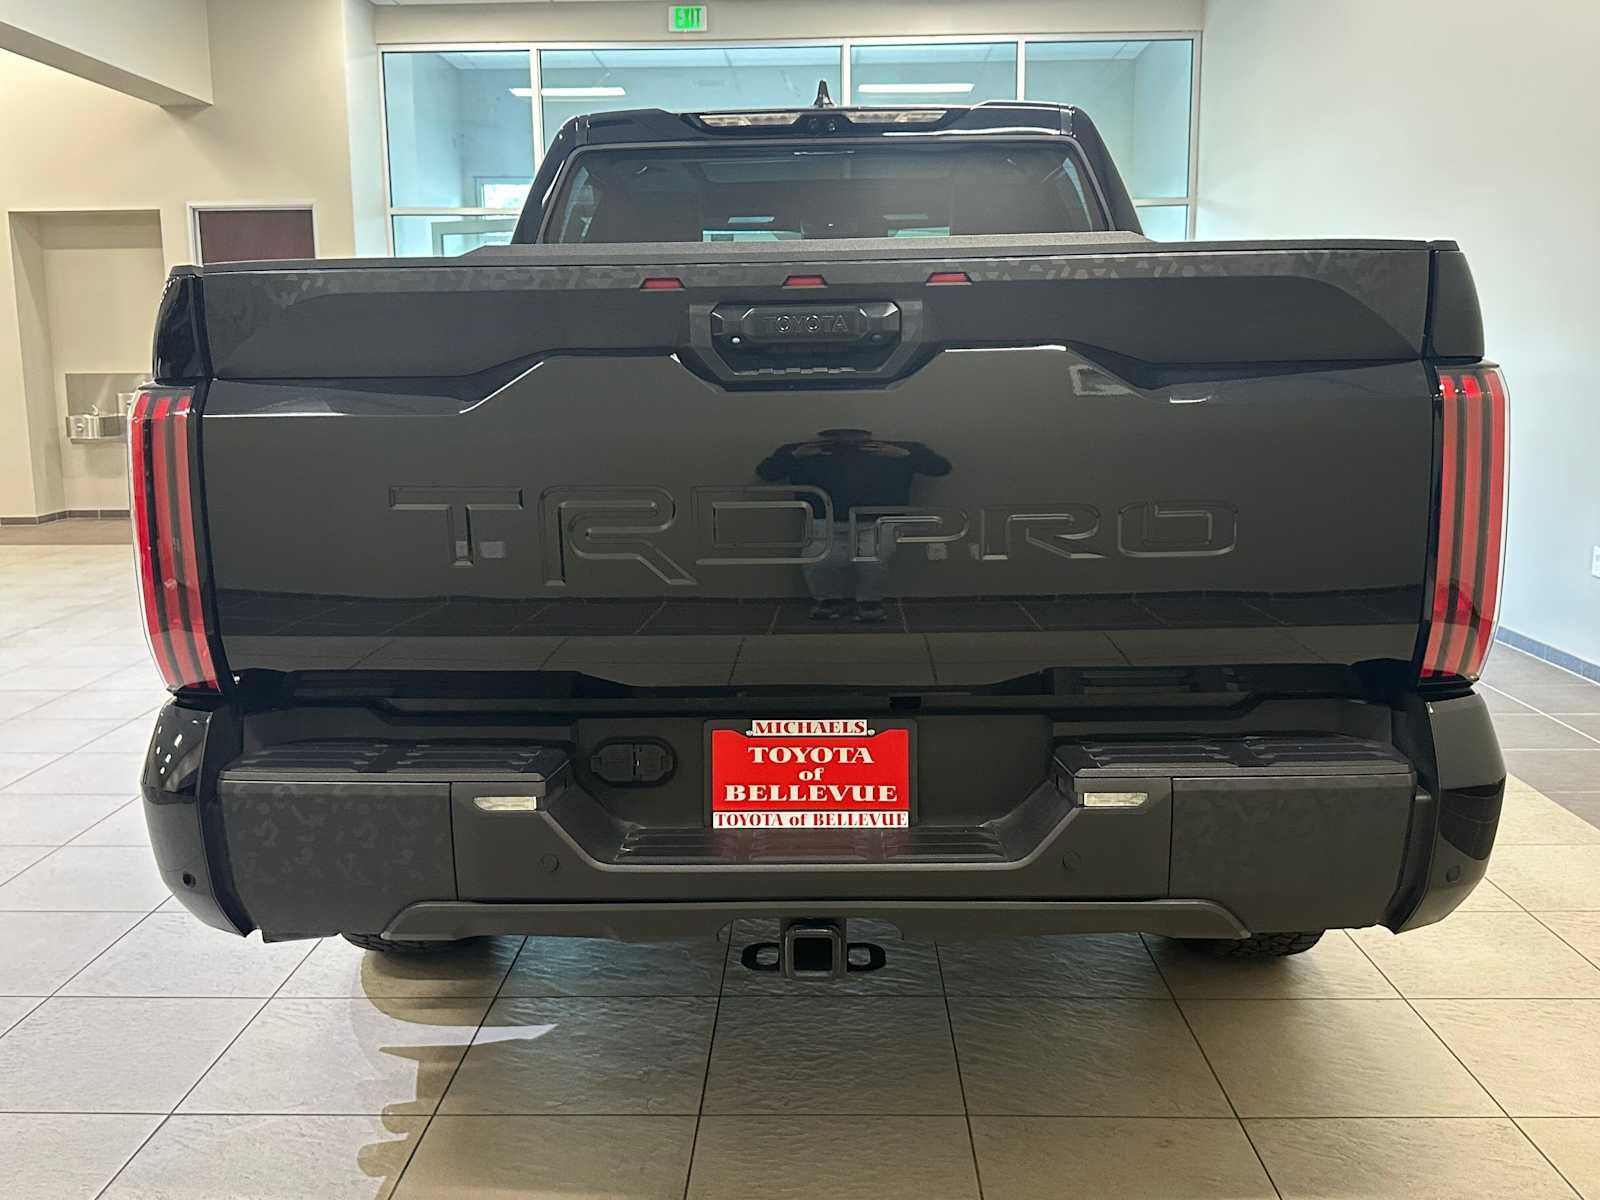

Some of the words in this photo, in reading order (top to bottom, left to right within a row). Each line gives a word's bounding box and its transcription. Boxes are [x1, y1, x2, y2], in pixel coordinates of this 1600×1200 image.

[675, 7, 702, 29] EXIT
[762, 315, 849, 333] TOYOTA
[388, 484, 833, 587] TRD
[848, 499, 1239, 563] PRO
[754, 721, 865, 734] MICHAELS
[748, 747, 875, 764] TOYOTA
[798, 767, 825, 782] of
[724, 784, 898, 802] BELLEVUE
[715, 813, 783, 826] TOYOTA
[789, 813, 808, 826] of
[813, 813, 907, 826] BELLEVUE
